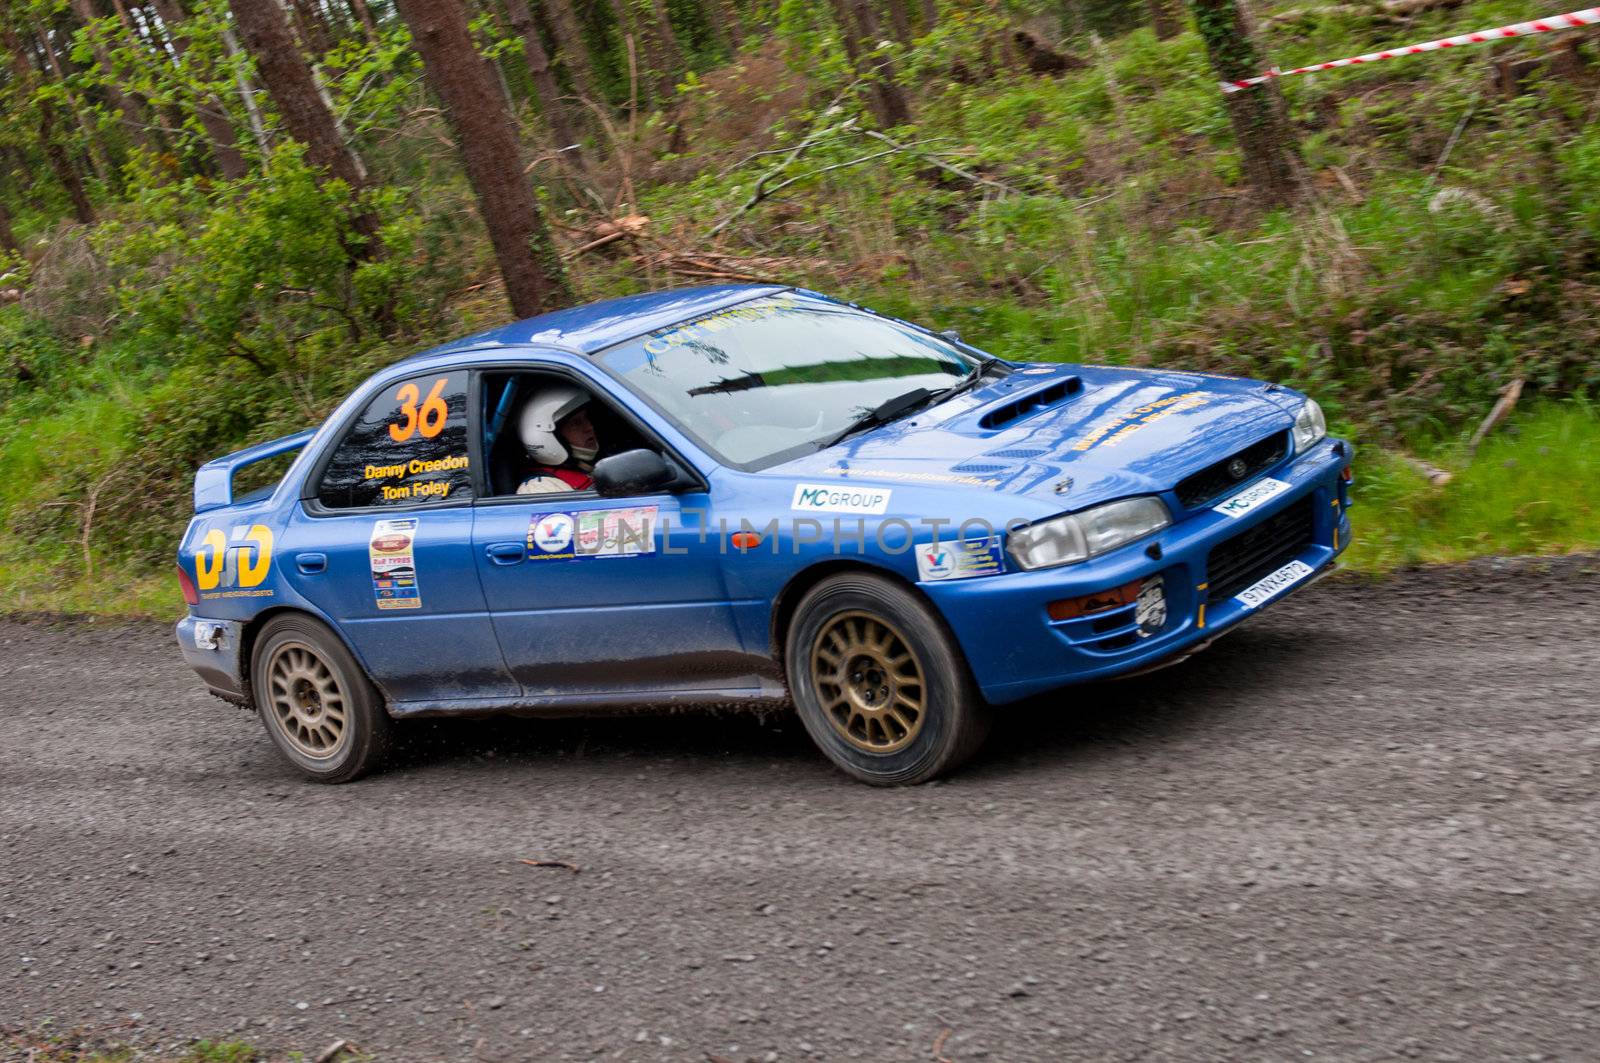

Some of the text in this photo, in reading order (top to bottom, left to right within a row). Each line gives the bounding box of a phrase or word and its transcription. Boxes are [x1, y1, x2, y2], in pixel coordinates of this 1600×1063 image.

[388, 378, 449, 443] 36
[364, 455, 469, 480] Danny Creedon
[381, 480, 449, 500] Tom Foley
